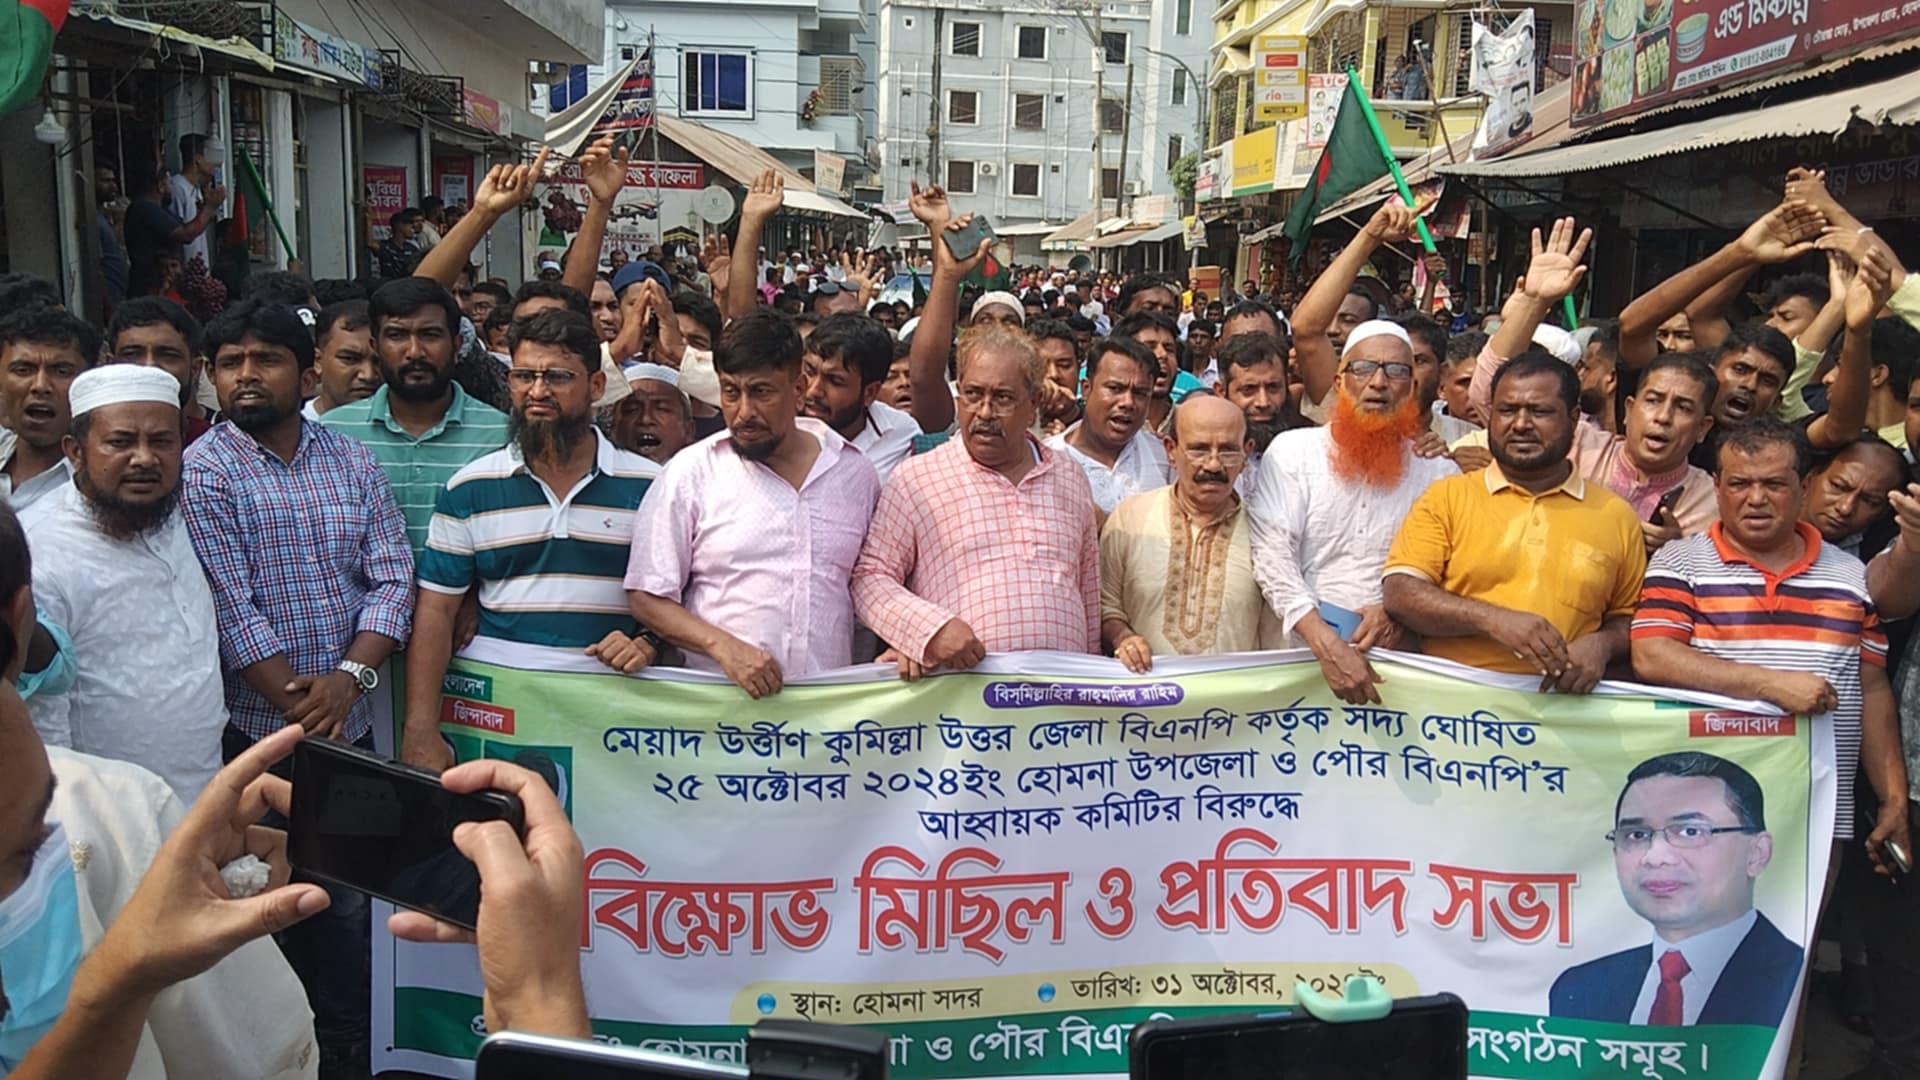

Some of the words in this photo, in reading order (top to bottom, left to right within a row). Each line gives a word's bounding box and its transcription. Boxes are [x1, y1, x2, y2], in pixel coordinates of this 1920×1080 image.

[453, 700, 505, 730] জিন্দাবাদ
[602, 726, 706, 756] মেয়াদ
[820, 719, 927, 766] কুমিল্লা
[937, 713, 1016, 751] উত্তর
[1029, 716, 1108, 750] জেলা
[1117, 708, 1237, 743] বিএনপি
[1247, 697, 1333, 747] কর্তৃক
[1341, 707, 1408, 738] সদ্য
[1422, 709, 1542, 748] ঘোষিত
[1703, 712, 1780, 735] জিন্দাবাদ
[653, 772, 704, 803] ২৫
[715, 766, 851, 802] অক্টোবর
[863, 760, 1005, 801] ২০২৪ইং
[1018, 756, 1118, 796] হোমনা
[1127, 748, 1259, 782] উপজেলা
[1272, 750, 1297, 776] ও
[1313, 740, 1390, 777] পৌর
[1073, 789, 1185, 829] কমিটির
[1195, 784, 1303, 820] বিরুদ্ধে
[579, 846, 838, 957] বিক্ষোভ
[853, 844, 1073, 965] মিছিল
[1083, 864, 1138, 941] ও
[1155, 826, 1416, 938] প্রতিবাদ
[1428, 861, 1580, 948] সভা
[852, 988, 924, 1017] হোমনা
[934, 986, 984, 1012] সদর
[1151, 973, 1182, 997] ৩১
[1191, 967, 1283, 1000] অক্টোবর,
[925, 1036, 953, 1061] ও
[969, 1020, 1050, 1061] পৌর
[1467, 1018, 1588, 1069] সংগঠন
[1595, 1038, 1688, 1080] সমূহ
